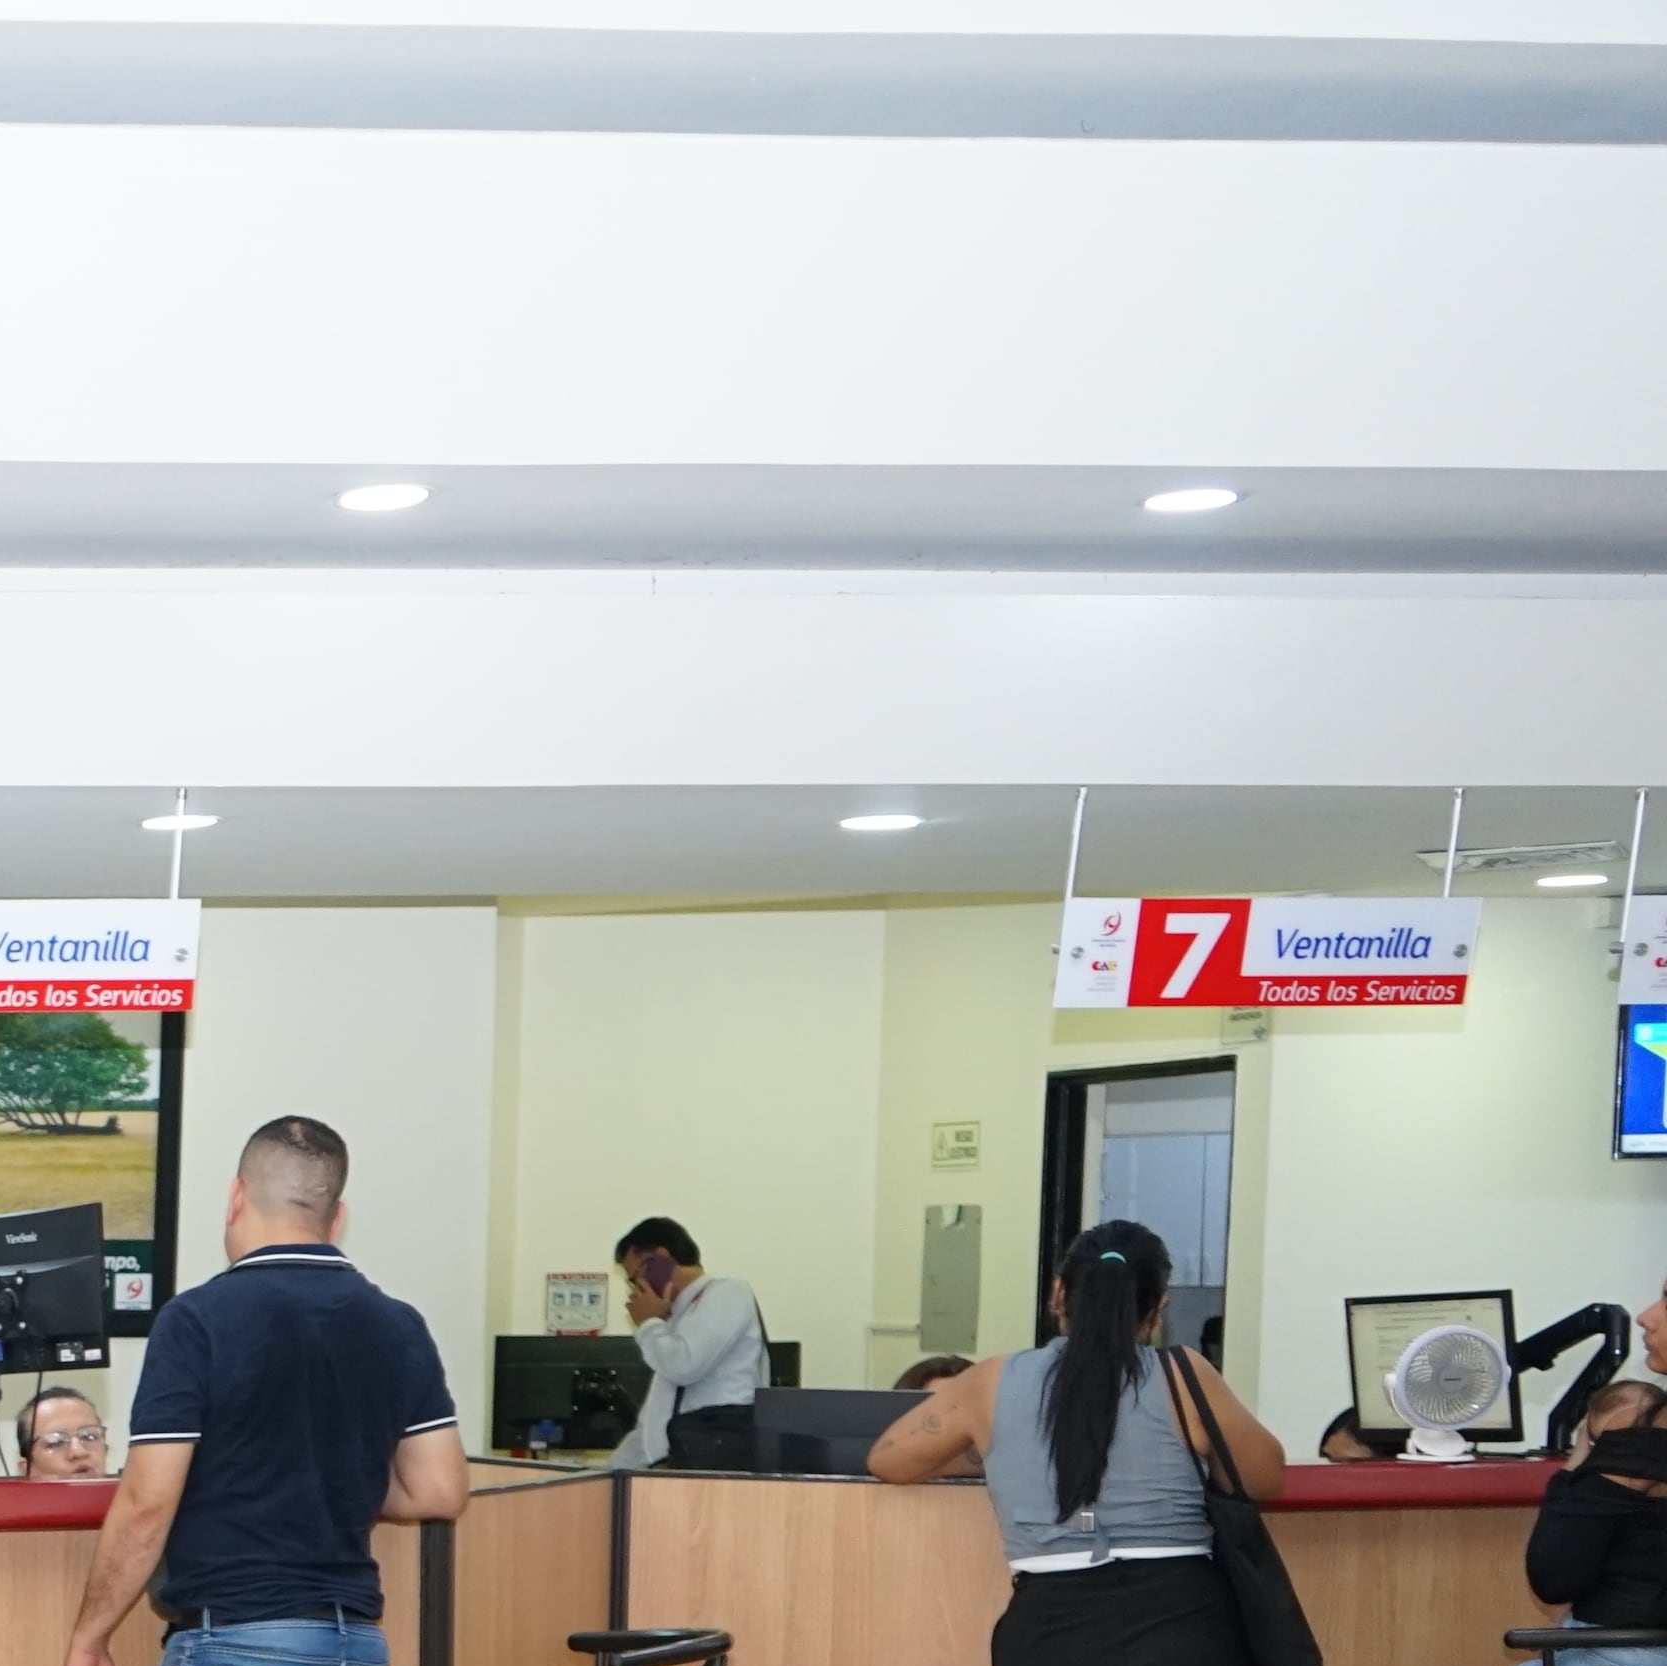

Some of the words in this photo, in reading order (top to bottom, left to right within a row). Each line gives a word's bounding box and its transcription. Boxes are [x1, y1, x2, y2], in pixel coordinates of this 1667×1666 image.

[1160, 912, 1232, 999] 7
[1274, 926, 1435, 961] Ventanilla
[45, 984, 78, 1007] los
[84, 983, 184, 1007] Servicios
[1259, 980, 1321, 1002] Todos
[1327, 980, 1358, 1002] los
[1365, 980, 1456, 1002] Servicios
